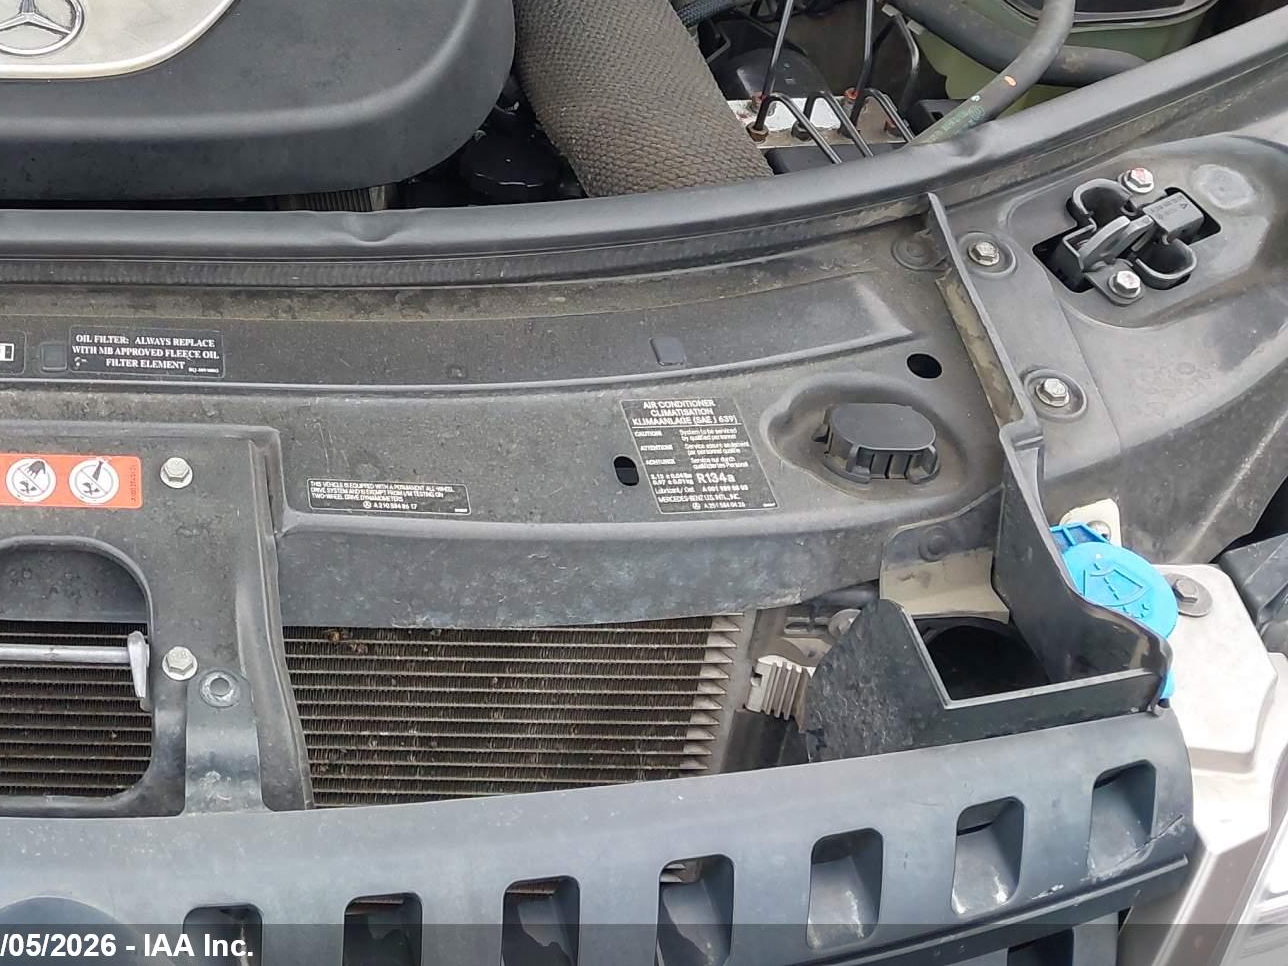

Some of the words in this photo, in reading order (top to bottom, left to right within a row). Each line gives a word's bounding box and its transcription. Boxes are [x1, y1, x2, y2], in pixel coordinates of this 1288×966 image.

[76, 334, 92, 343] OIL
[94, 335, 129, 345] FILTER:
[135, 337, 171, 346] ALWAYS
[173, 338, 215, 348] REPLACE
[72, 346, 97, 355] WITH
[99, 347, 113, 355] MB
[115, 348, 163, 357] APPROVED
[165, 349, 201, 359] FLEECE
[203, 350, 220, 359] OIL
[106, 358, 139, 368] FILTER
[140, 359, 185, 370] ELEMENT
[643, 401, 658, 409] AIR
[659, 400, 716, 408] CONDITIONER
[650, 408, 714, 417] CLIMATISATION
[632, 417, 693, 425] KLIMAANLAGE
[696, 472, 736, 484] R134a
